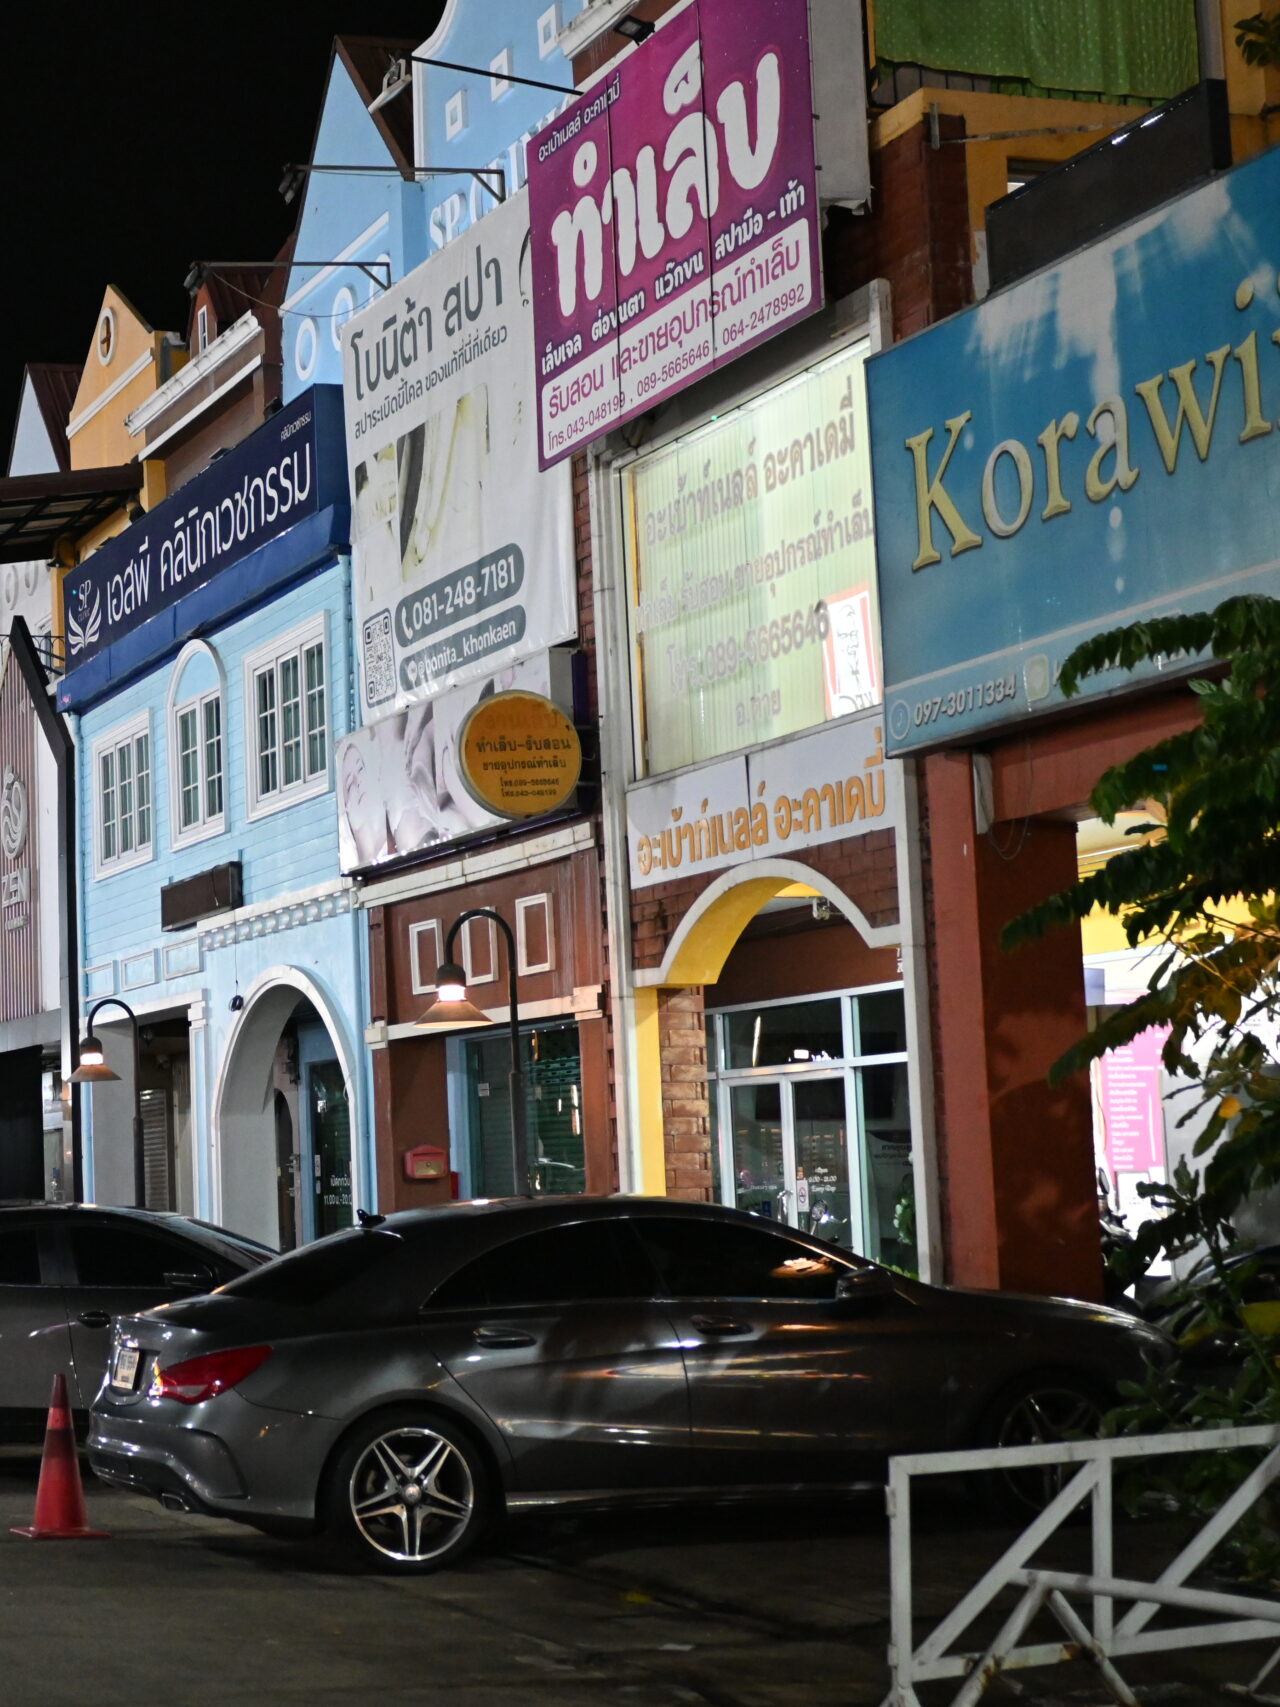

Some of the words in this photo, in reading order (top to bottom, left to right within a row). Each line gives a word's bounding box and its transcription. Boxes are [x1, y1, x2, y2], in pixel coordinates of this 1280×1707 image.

[551, 39, 780, 317] ทำเล็บ
[350, 297, 433, 401] โบนิต้า
[443, 245, 503, 337] สปา
[541, 333, 582, 375] เล็บเจล
[591, 292, 645, 342] ต่อขนตา
[714, 208, 763, 260] สปามือ
[779, 179, 805, 215] เท้า
[549, 366, 604, 420] รับสอน
[611, 237, 800, 382] และขายอุปกรณ์ทำเล็บ
[637, 339, 710, 398] 089-5665646
[722, 283, 805, 345] 064-2478992
[762, 374, 855, 494] อะคาเดมี่
[905, 268, 1280, 572] Korawi
[106, 536, 151, 625] เอสพี
[160, 443, 311, 592] คลินิกเวชกรรม
[413, 554, 516, 630] 081-248-7181
[914, 672, 1017, 727] 097-3011334
[774, 727, 885, 840] อะคาเดมี่
